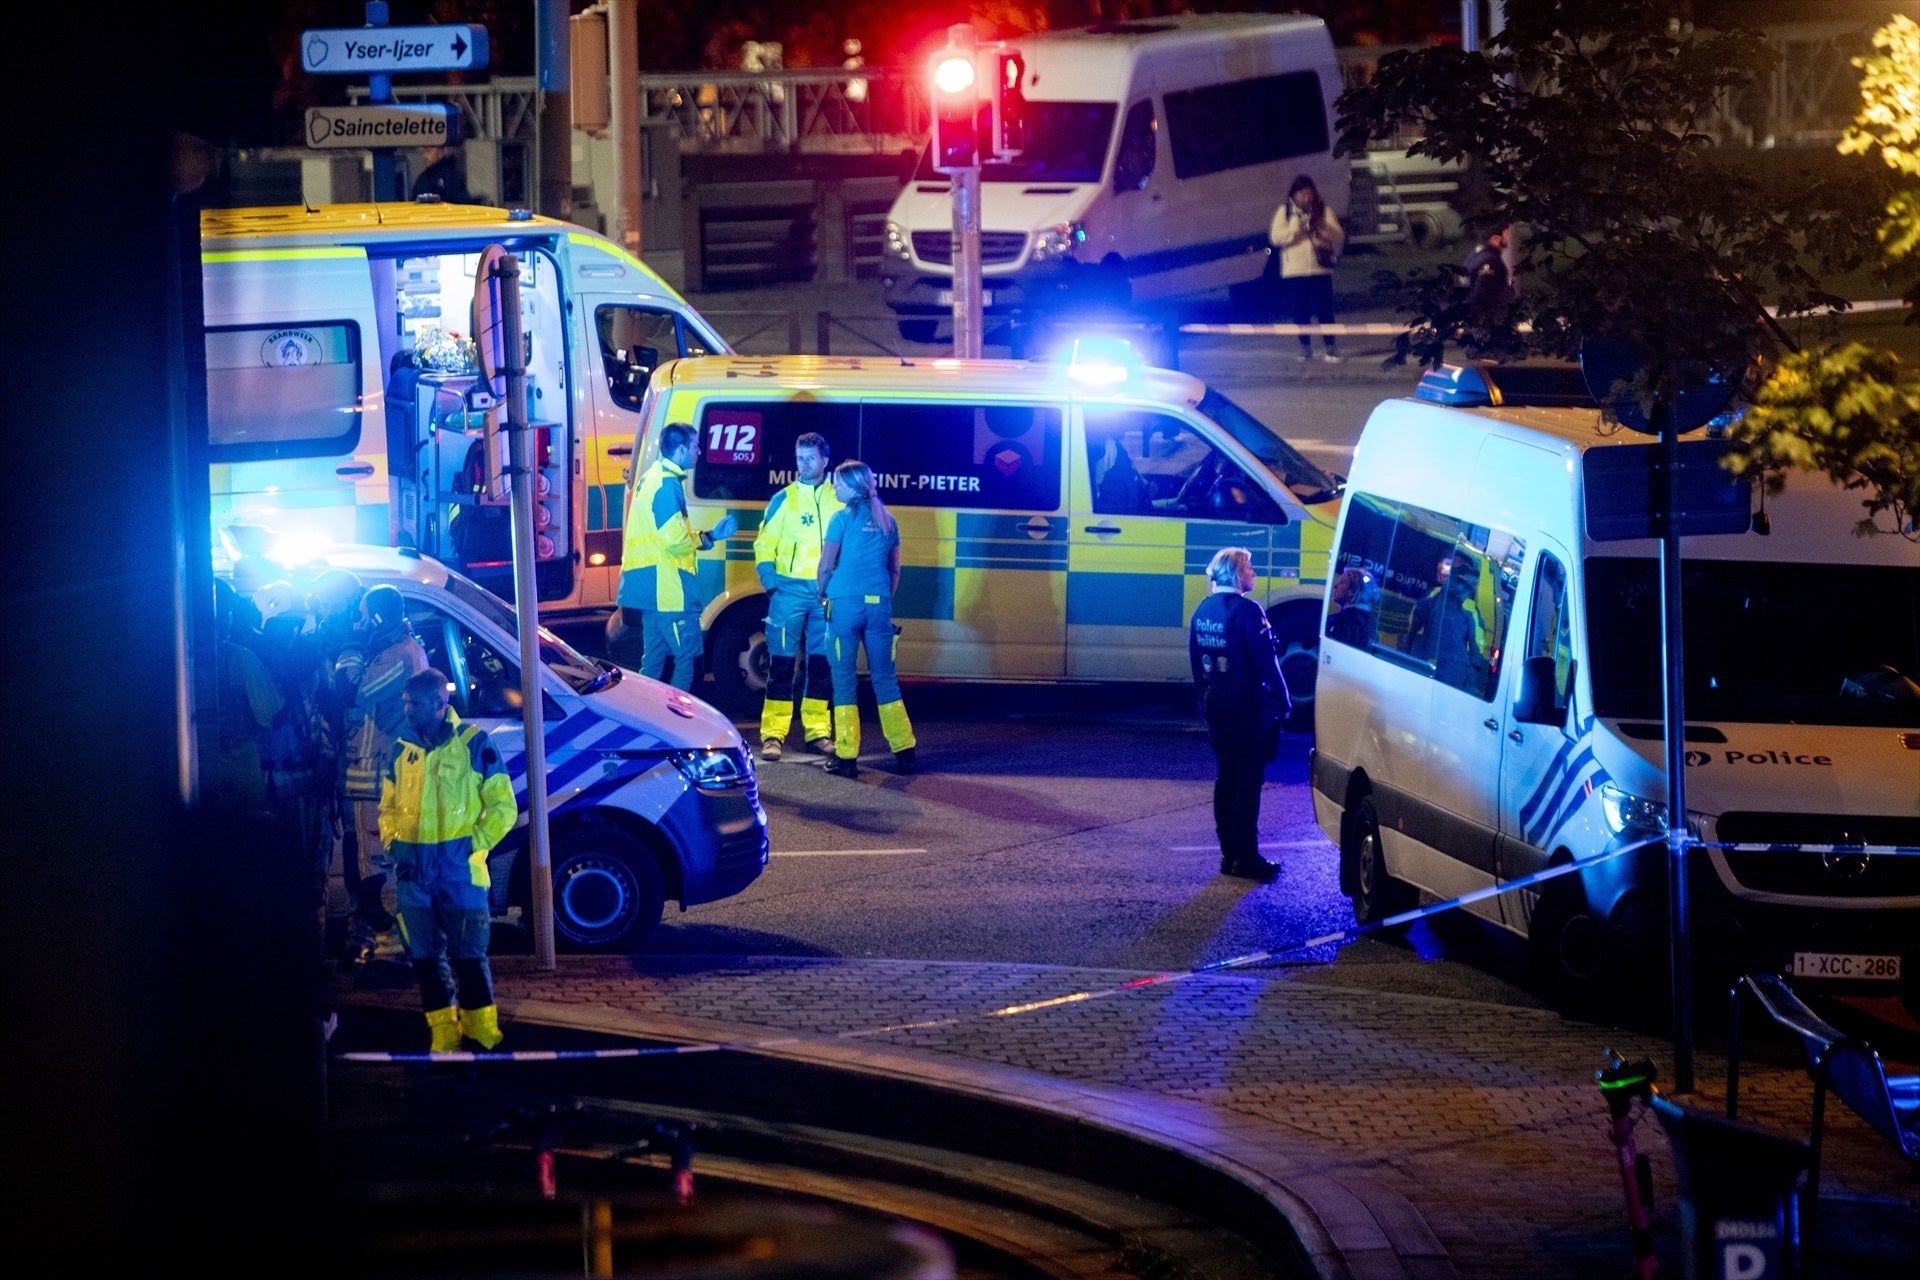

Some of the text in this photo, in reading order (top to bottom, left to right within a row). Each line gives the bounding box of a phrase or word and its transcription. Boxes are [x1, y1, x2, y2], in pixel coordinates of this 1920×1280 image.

[345, 40, 434, 61] Yser-Ijzer
[333, 117, 446, 137] Sainctelette
[709, 423, 756, 451] 112
[1196, 618, 1224, 633] Police
[1196, 633, 1227, 648] Politie
[1725, 751, 1833, 766] Police
